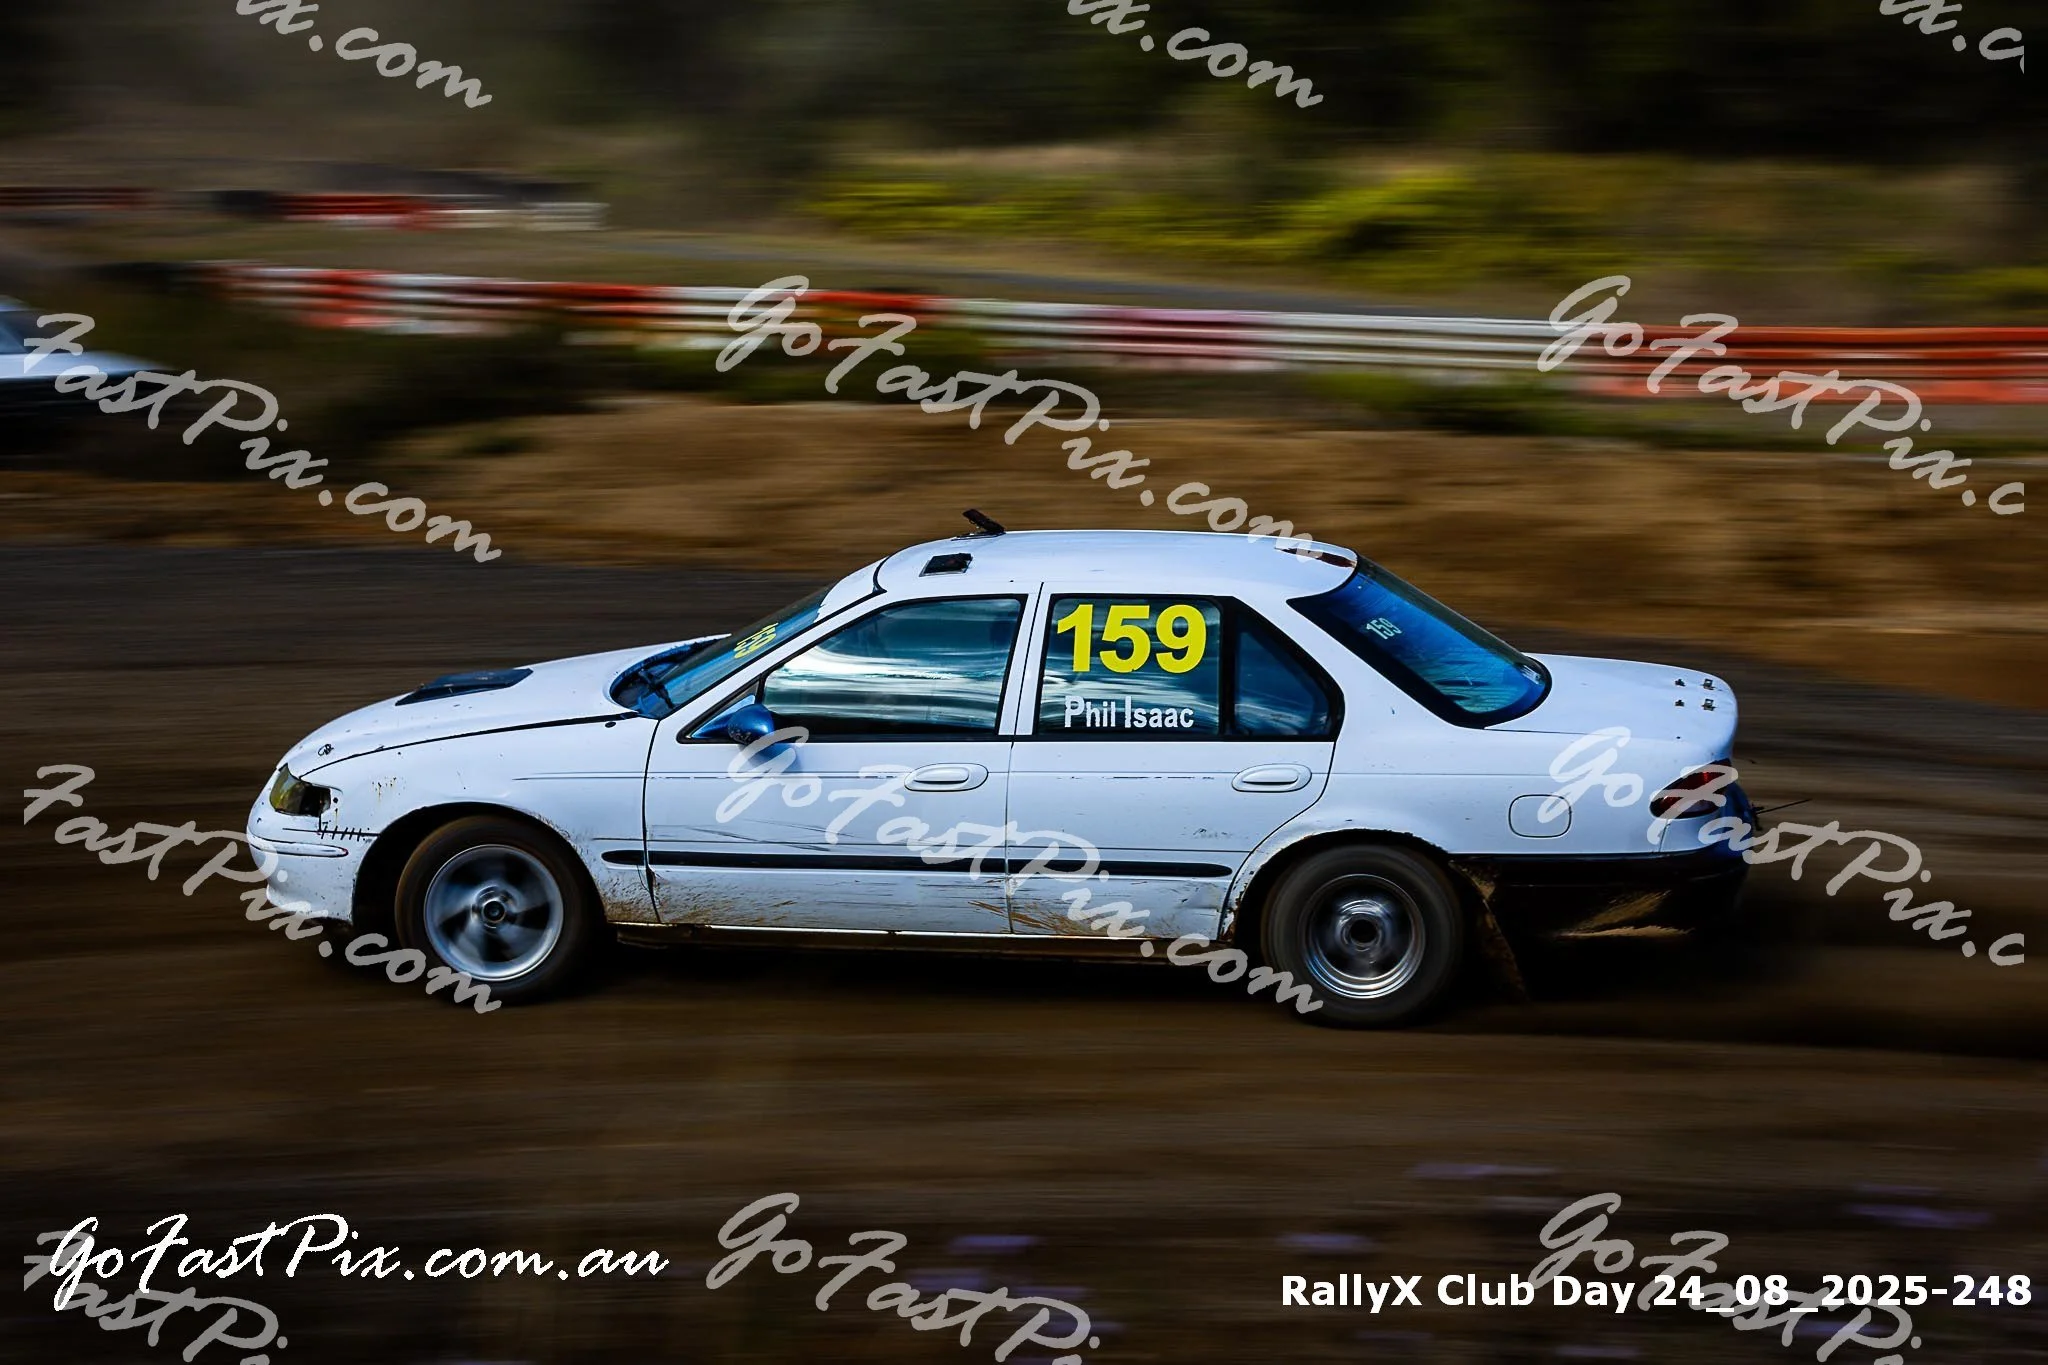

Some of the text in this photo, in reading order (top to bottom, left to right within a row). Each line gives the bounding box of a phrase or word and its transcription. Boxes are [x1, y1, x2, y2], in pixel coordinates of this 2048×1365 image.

[1057, 604, 1207, 673] 159
[1366, 617, 1402, 640] 159
[1064, 695, 1194, 728] Phil Isaac
